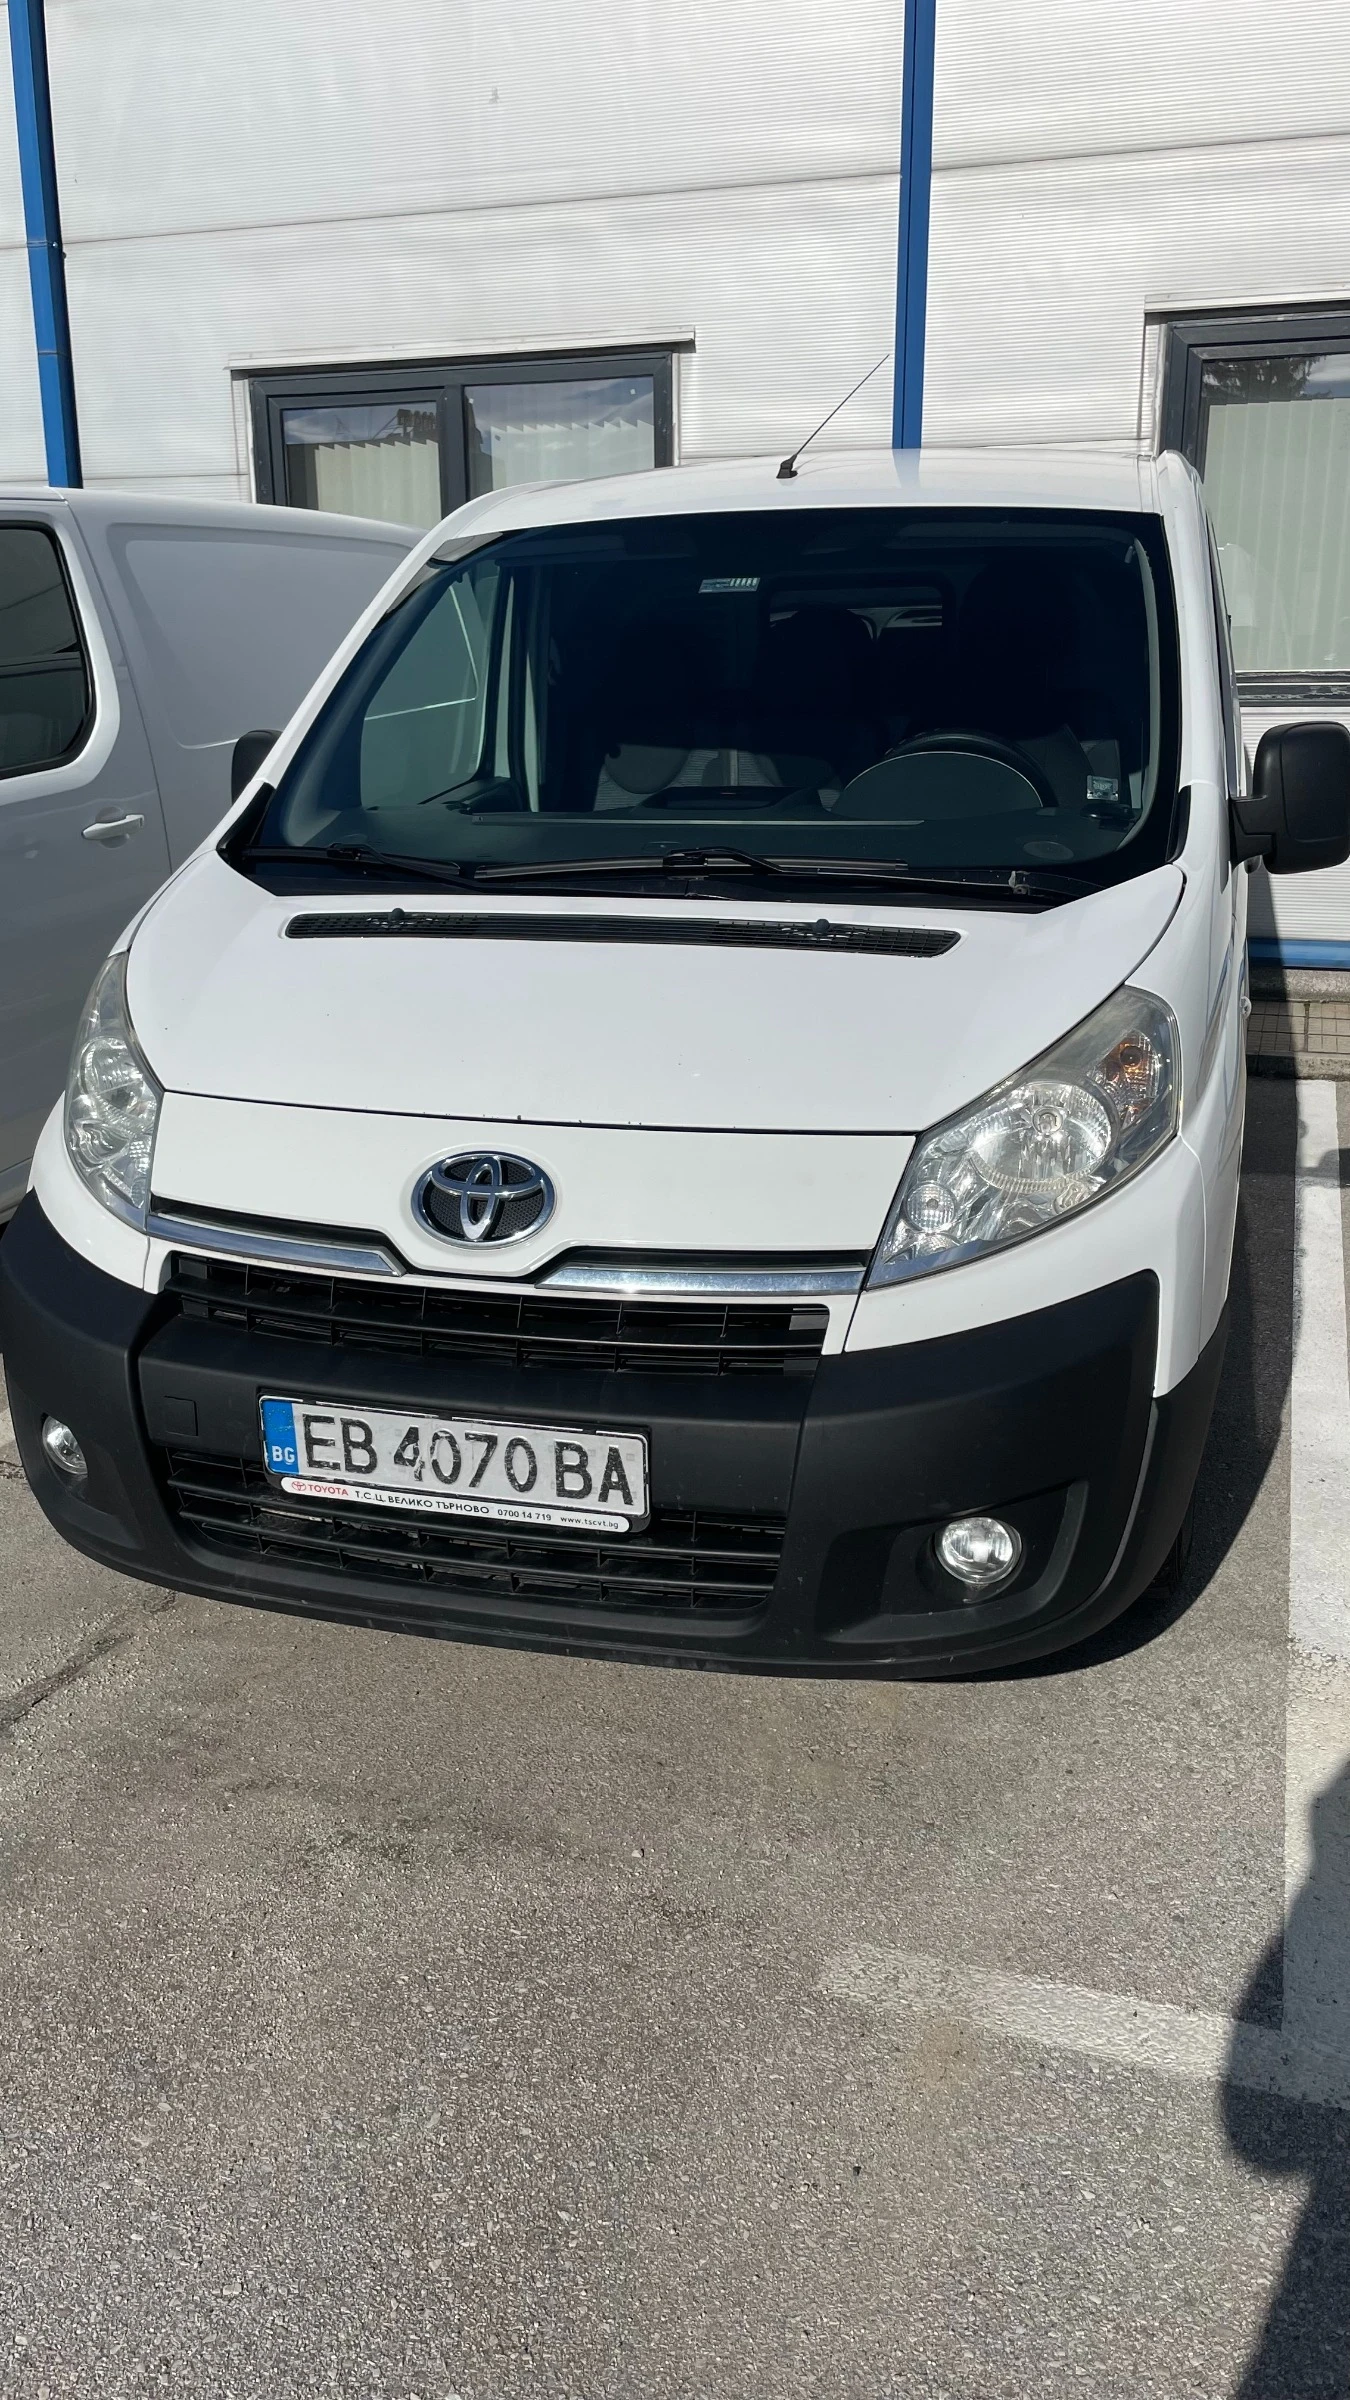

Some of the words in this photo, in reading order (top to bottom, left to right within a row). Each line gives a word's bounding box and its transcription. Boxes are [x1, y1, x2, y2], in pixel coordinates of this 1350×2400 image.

[271, 1446, 295, 1465] BG
[303, 1414, 377, 1473] EB
[393, 1425, 538, 1493] 4070
[554, 1440, 633, 1505] BA
[308, 1484, 349, 1496] TOYOTA
[388, 1496, 433, 1508] ВЕЛИКО
[436, 1501, 490, 1514] ТЪРНОВО
[497, 1509, 520, 1518] 0700
[535, 1513, 552, 1521] 719
[560, 1516, 620, 1530] www.tscvt.bg
